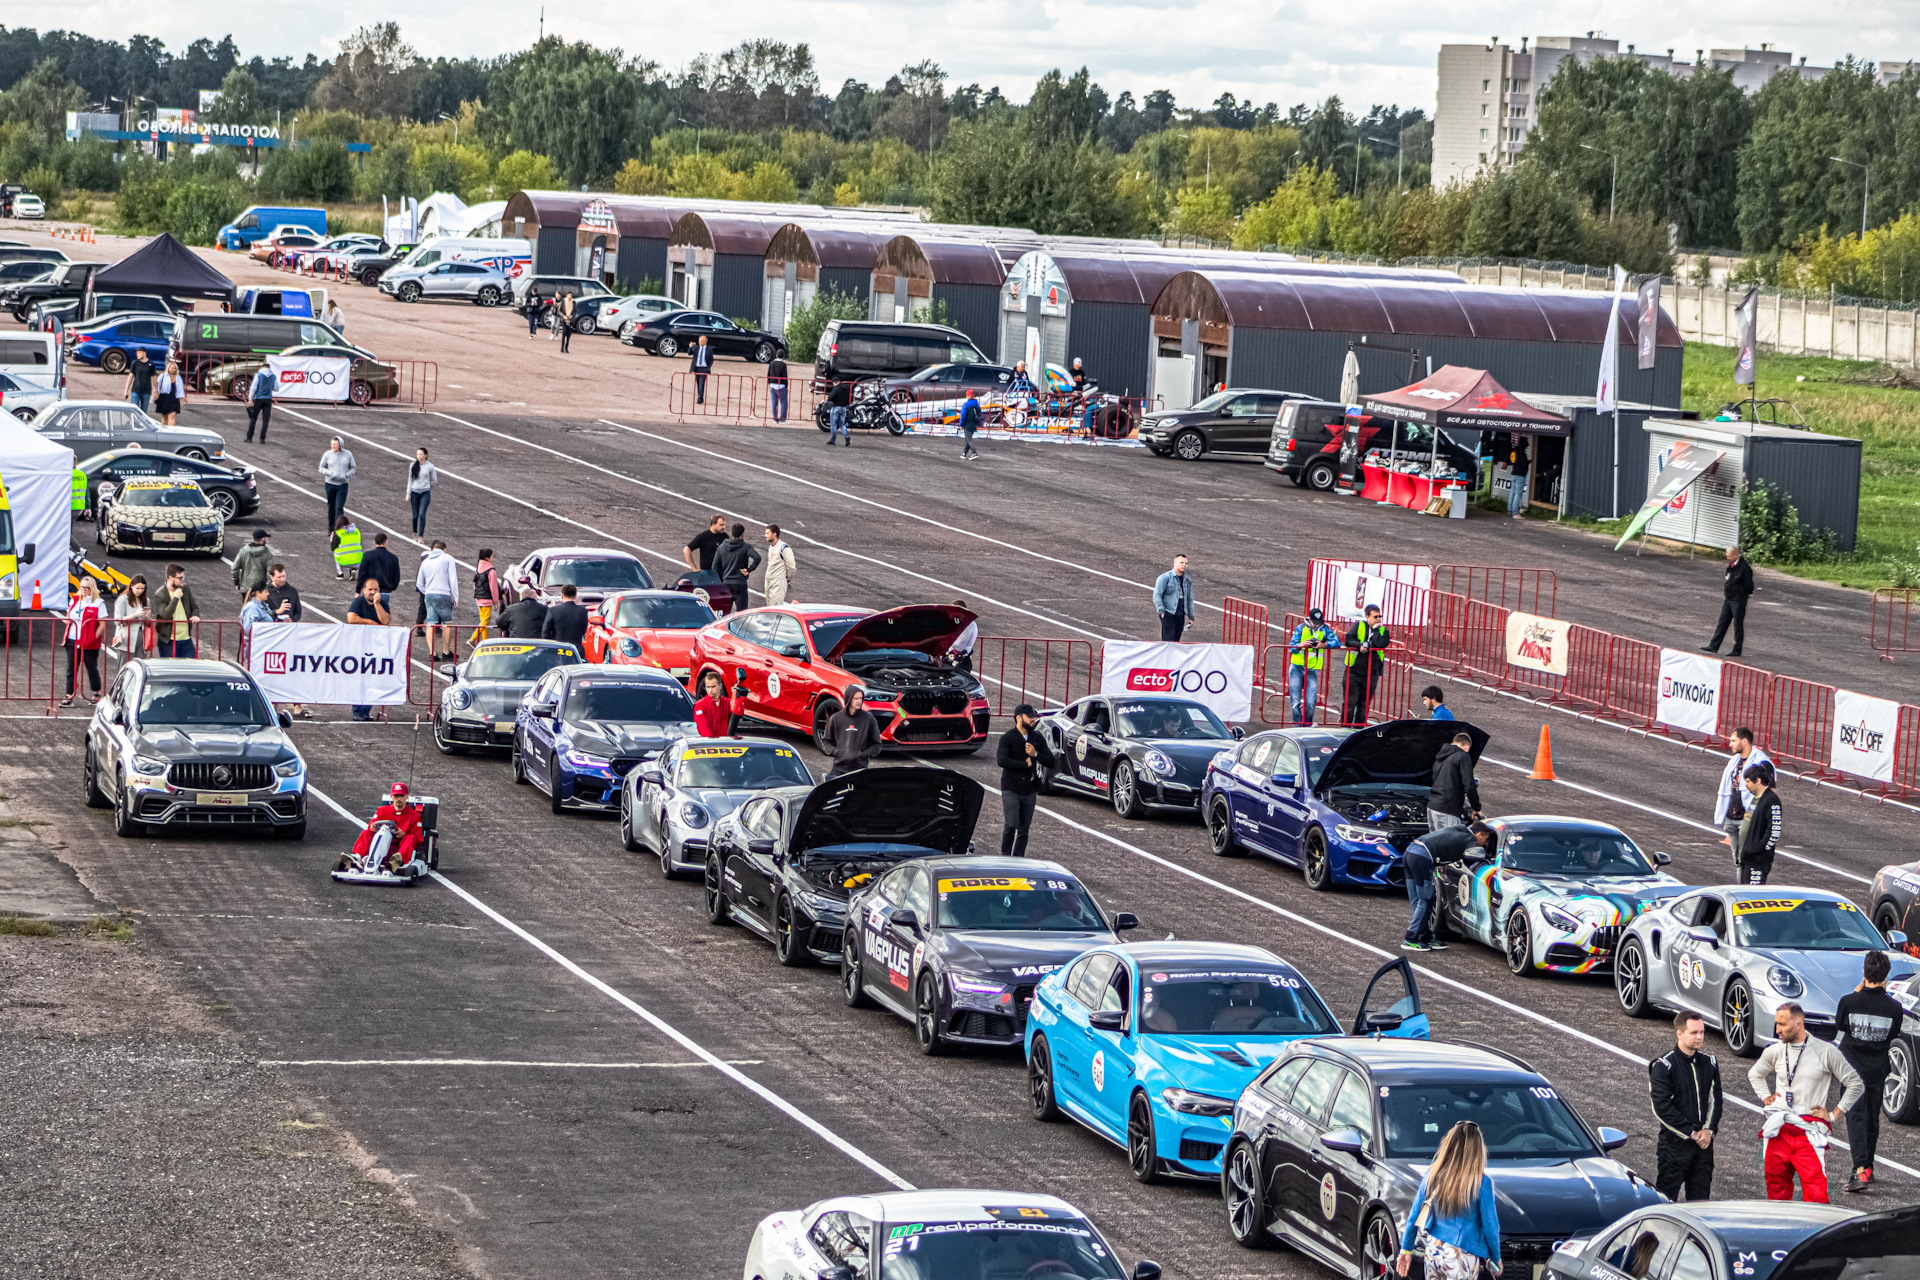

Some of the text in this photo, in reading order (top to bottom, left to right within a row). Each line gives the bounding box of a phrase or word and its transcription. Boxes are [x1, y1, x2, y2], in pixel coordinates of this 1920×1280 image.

[202, 324, 218, 338] 21
[1477, 419, 1520, 428] автоспорта
[1528, 422, 1561, 431] тюнинга
[480, 646, 522, 654] RDRC
[289, 652, 394, 675] ЛУКОЙЛ
[227, 682, 250, 691] 720
[771, 683, 777, 694] 13
[1672, 681, 1715, 706] ЛУКОЙЛ
[1840, 725, 1883, 751] DSC OFF
[694, 748, 744, 756] RDRC
[775, 748, 793, 757] 35
[1079, 764, 1108, 783] VAGPLUS
[951, 878, 1010, 888] RDRC
[1047, 881, 1068, 890] 88
[1892, 879, 1920, 895] CARTER.RU
[1737, 900, 1794, 910] RDRC
[1836, 902, 1857, 912] 33
[865, 927, 910, 977] VAGPLUS
[1211, 971, 1283, 979] Performance
[1268, 976, 1300, 988] 560
[1093, 1066, 1103, 1086] 560
[1529, 1087, 1558, 1099] 101
[1277, 1108, 1308, 1131] CARTER.RU
[1323, 1191, 1333, 1213] 101
[1017, 1208, 1049, 1218] 21
[890, 1223, 924, 1239] RP
[885, 1235, 921, 1255] 21
